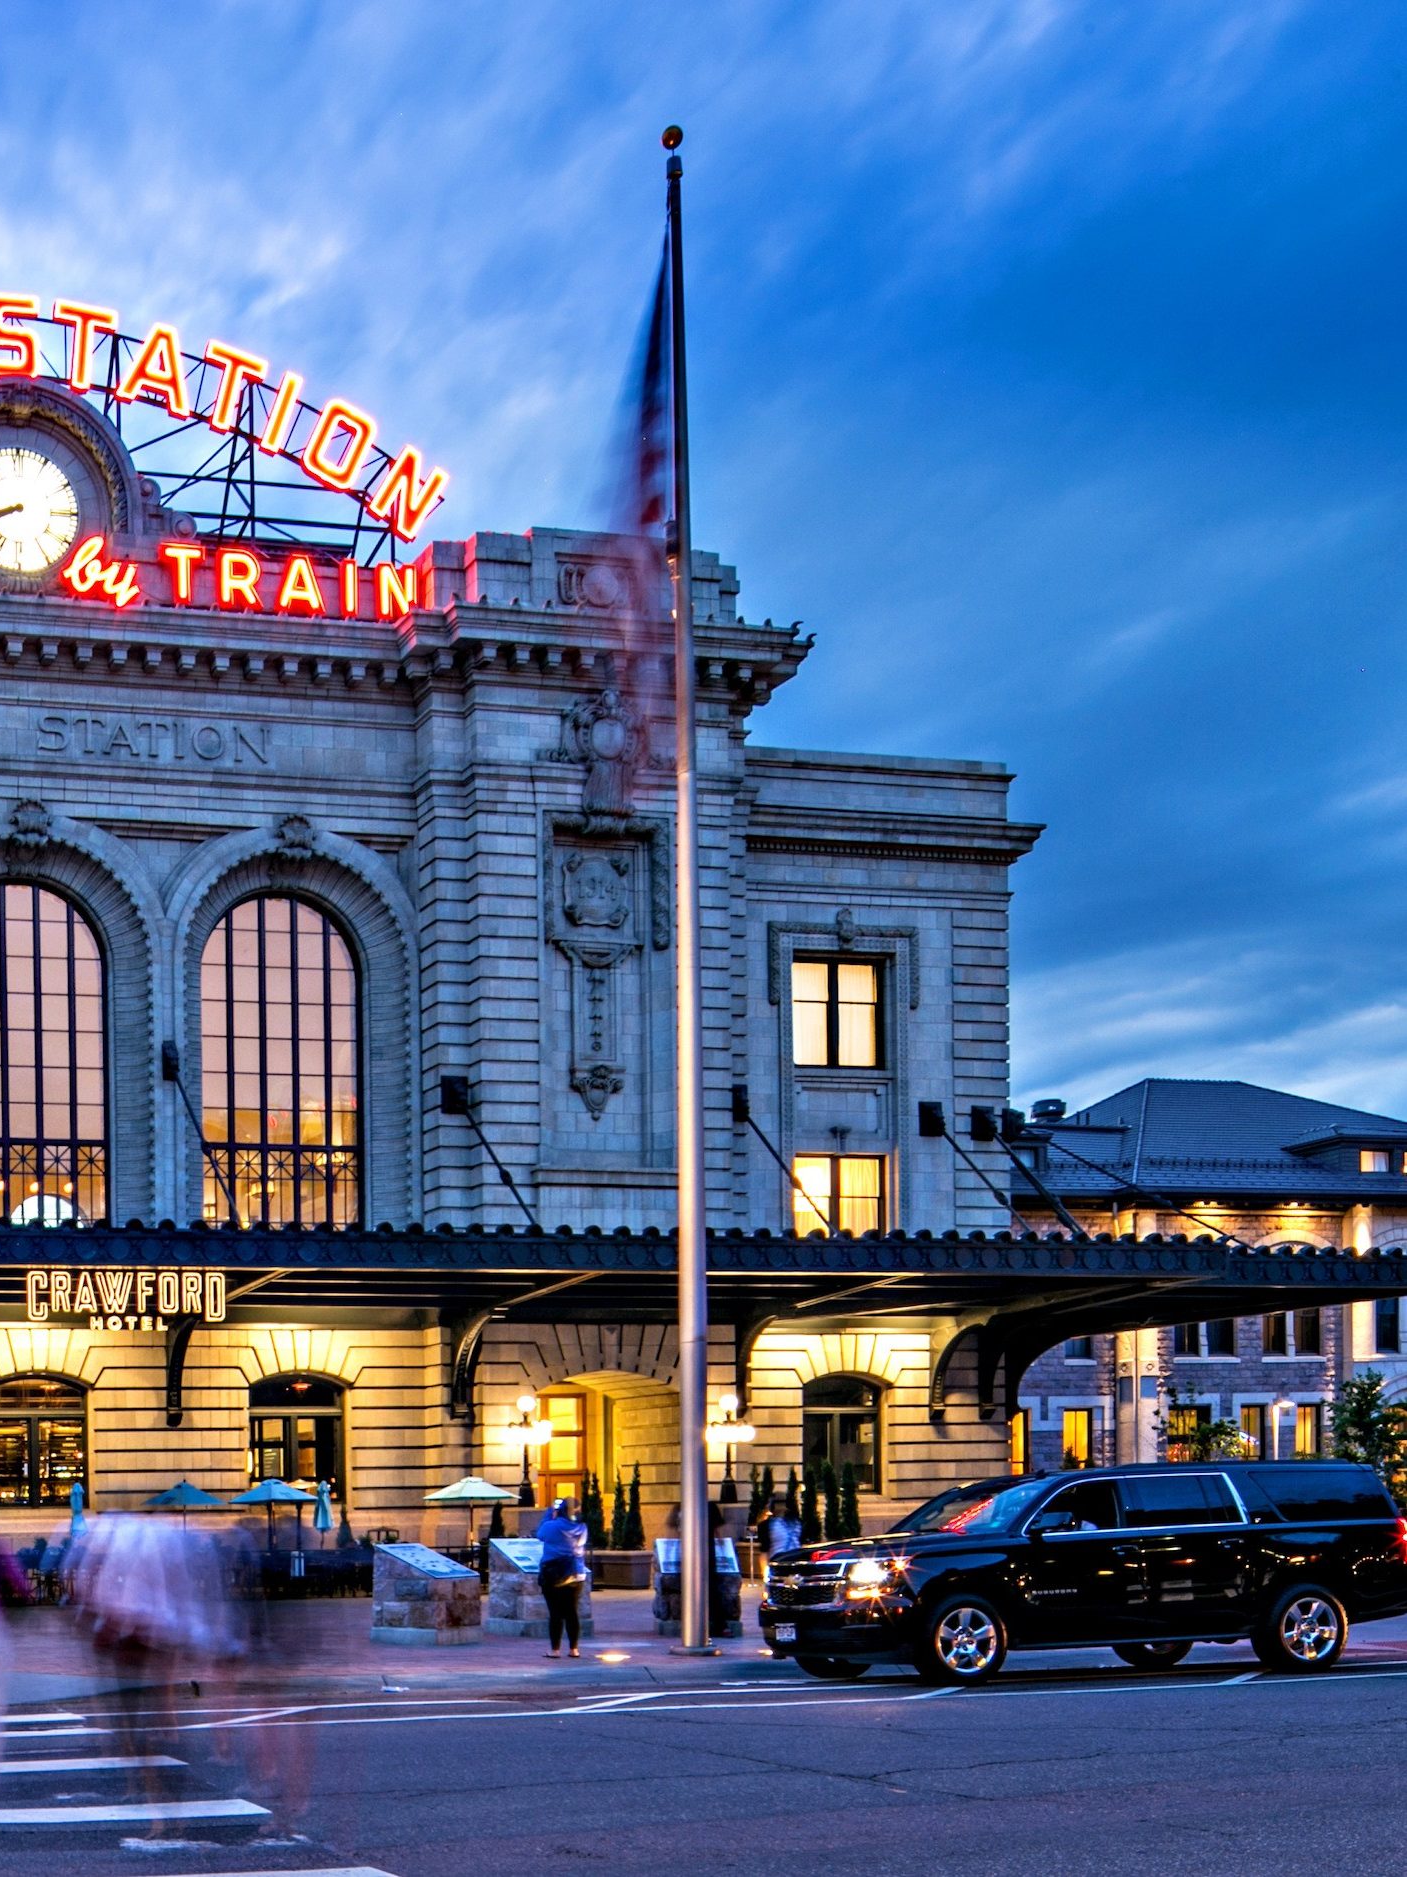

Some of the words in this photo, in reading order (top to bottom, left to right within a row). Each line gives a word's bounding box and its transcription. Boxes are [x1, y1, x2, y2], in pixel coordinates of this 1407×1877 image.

[62, 535, 141, 608] by
[159, 541, 418, 623] TRAIN
[37, 715, 271, 764] STATION
[26, 1270, 226, 1322] CRAWFORD
[89, 1315, 169, 1332] HOTEL
